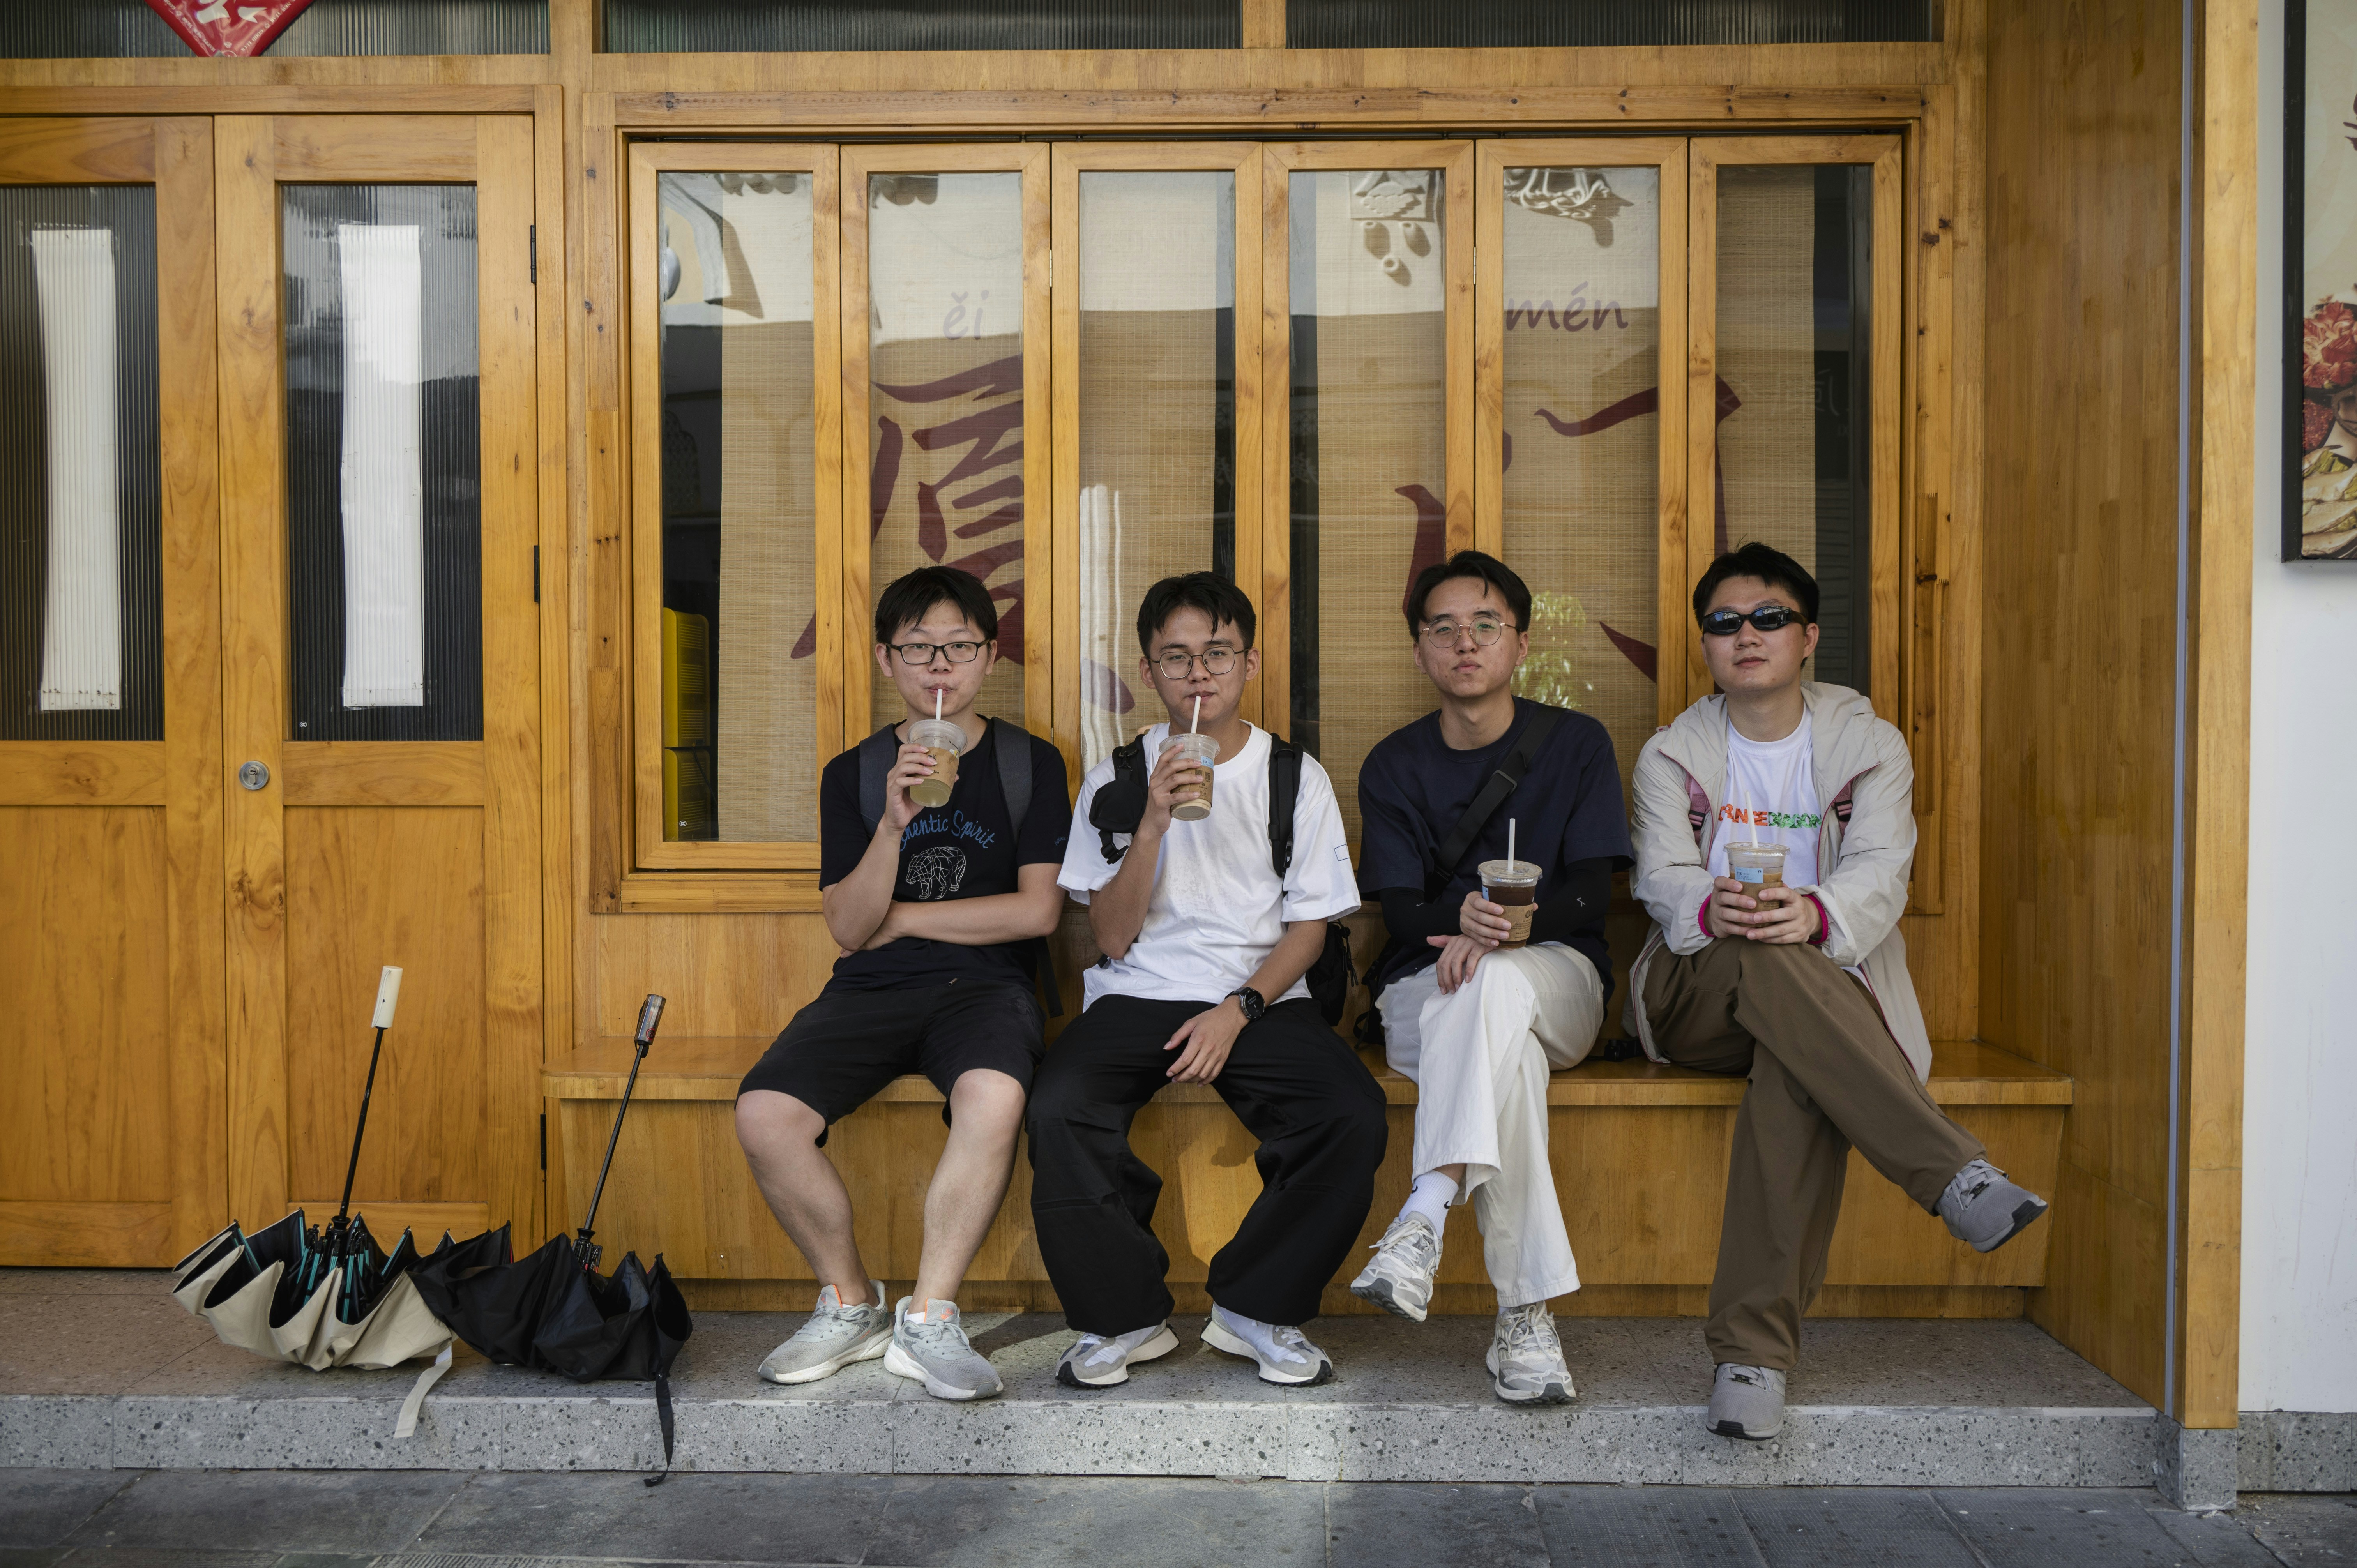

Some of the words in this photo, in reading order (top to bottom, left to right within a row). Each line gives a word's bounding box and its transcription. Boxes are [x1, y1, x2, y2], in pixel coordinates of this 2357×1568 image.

[202, 39, 216, 52] HAPPY
[252, 29, 264, 42] GOOD
[1506, 281, 1628, 332] mén
[951, 810, 995, 848] Spirit
